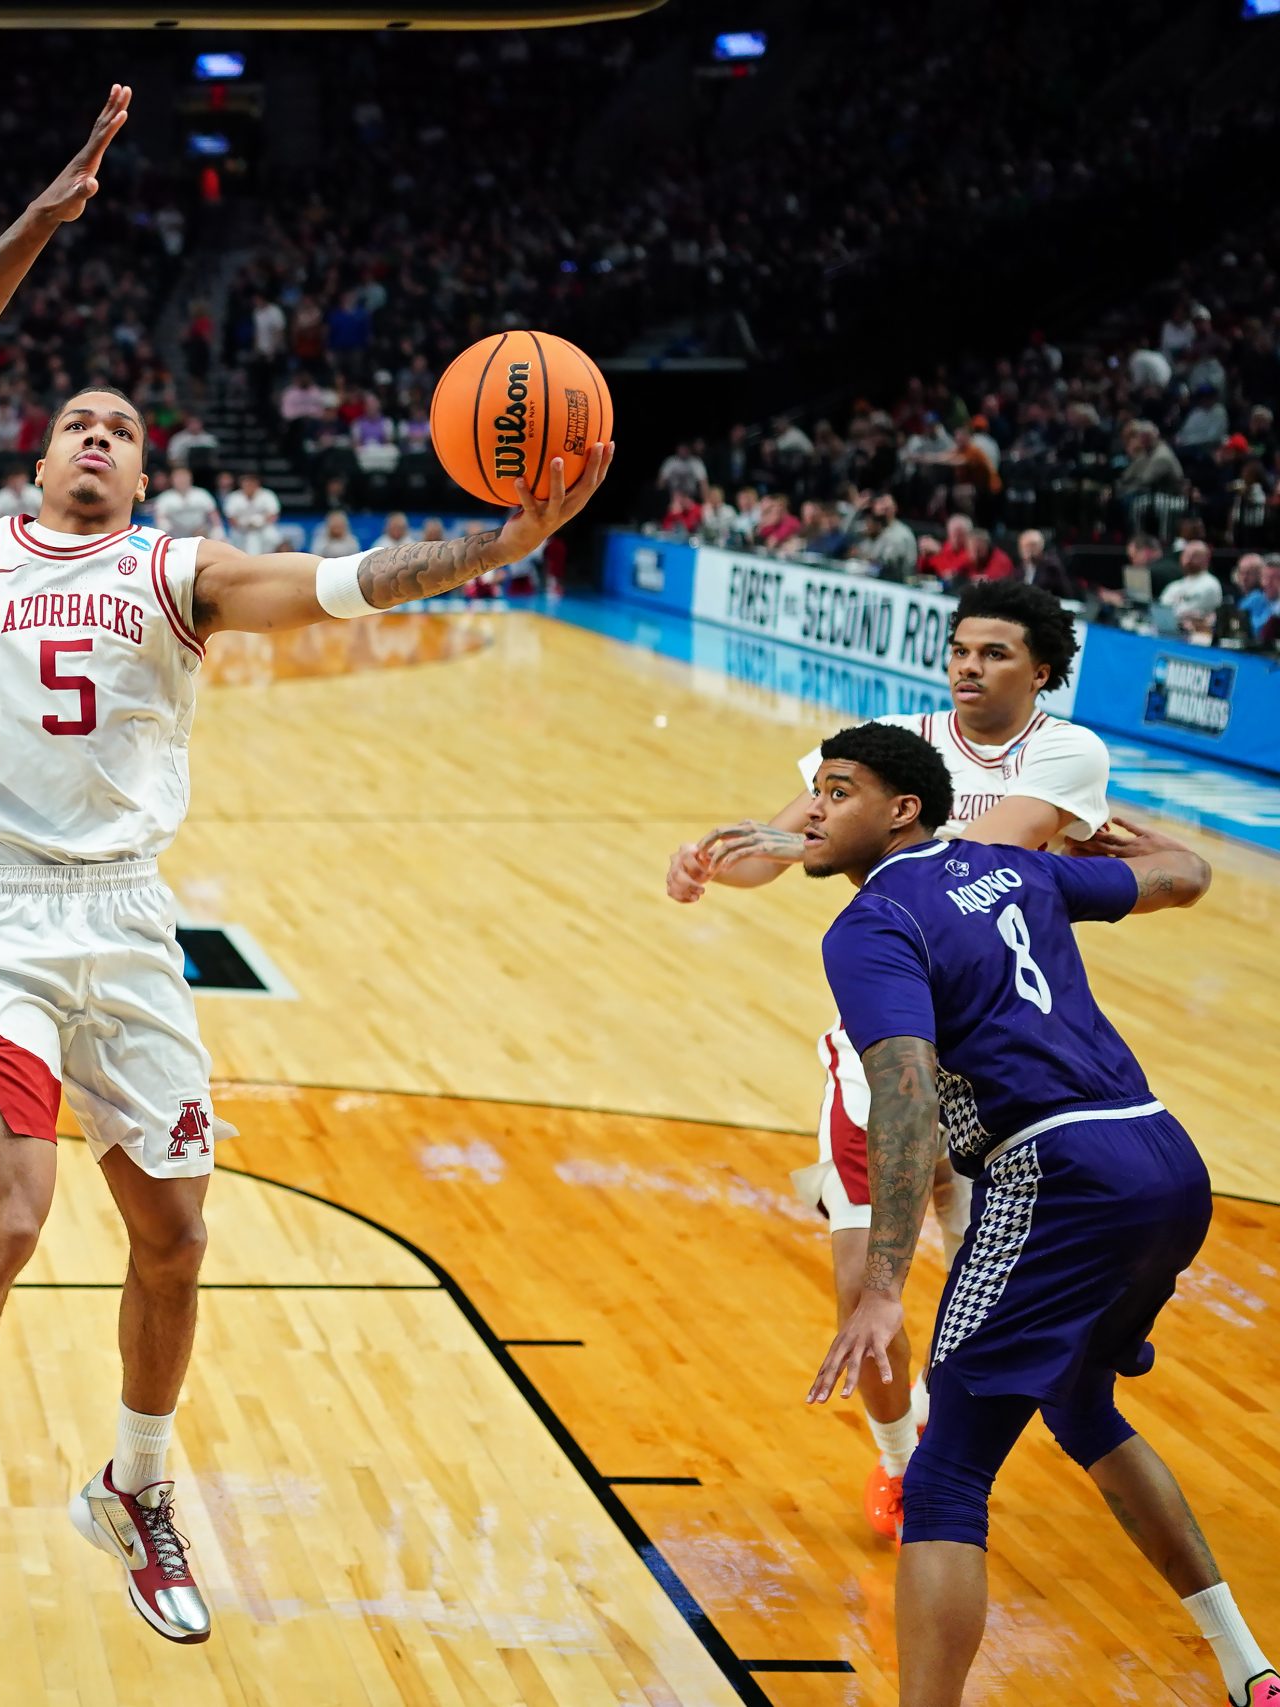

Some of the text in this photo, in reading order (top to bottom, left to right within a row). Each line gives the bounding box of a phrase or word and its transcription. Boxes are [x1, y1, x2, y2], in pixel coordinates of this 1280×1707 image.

[494, 361, 531, 479] Wilson
[567, 406, 578, 443] MARCH
[576, 390, 588, 438] MADNESS
[119, 557, 136, 574] SEC
[728, 564, 783, 630] FIRST
[801, 580, 893, 657] SECOND
[40, 638, 97, 736] 5
[1166, 660, 1212, 696] MARCH
[1166, 690, 1230, 731] MADNESS
[946, 868, 1022, 915] AQUINO
[997, 903, 1052, 1015] 8
